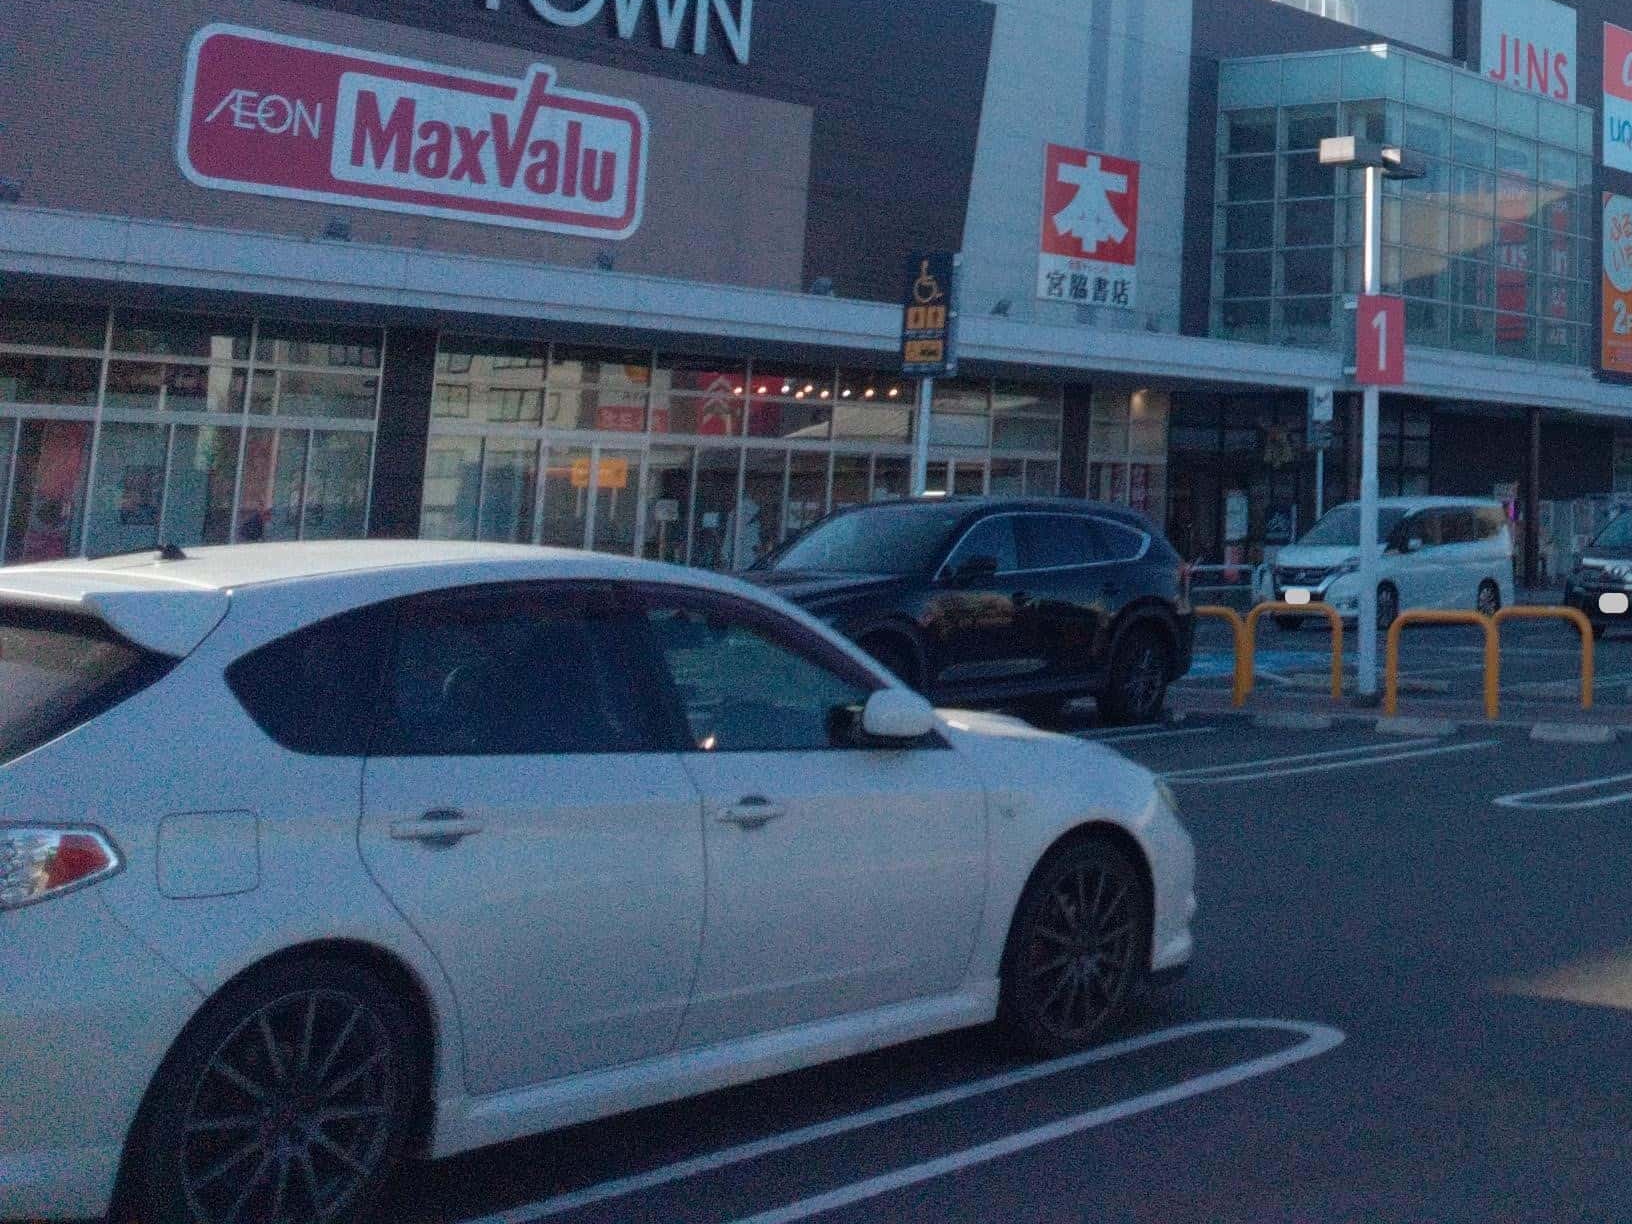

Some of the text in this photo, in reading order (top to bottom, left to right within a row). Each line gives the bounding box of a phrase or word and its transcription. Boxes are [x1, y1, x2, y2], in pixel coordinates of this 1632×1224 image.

[351, 68, 618, 203] MaxValu
[1610, 116, 1632, 150] UQ
[1371, 311, 1389, 371] 1
